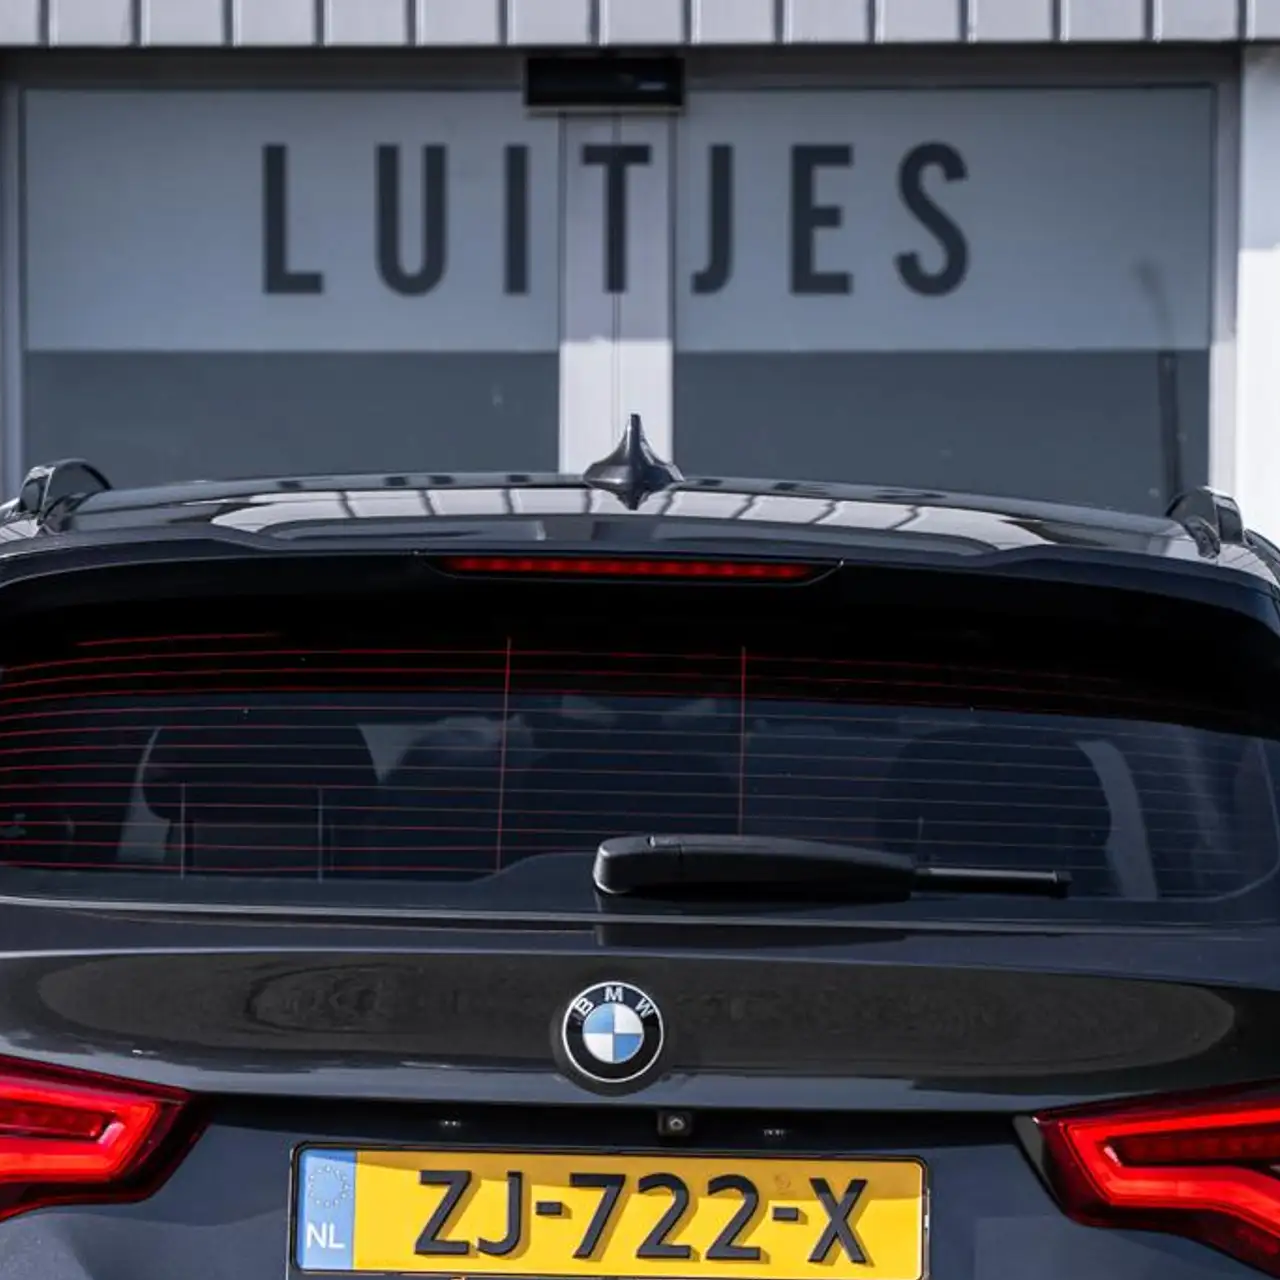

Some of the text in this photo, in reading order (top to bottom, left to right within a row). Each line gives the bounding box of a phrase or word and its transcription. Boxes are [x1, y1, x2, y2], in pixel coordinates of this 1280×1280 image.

[261, 141, 970, 297] LUITJES
[573, 985, 655, 1019] BMW
[306, 1222, 346, 1249] NL
[414, 1169, 867, 1265] ZJ-722-X
